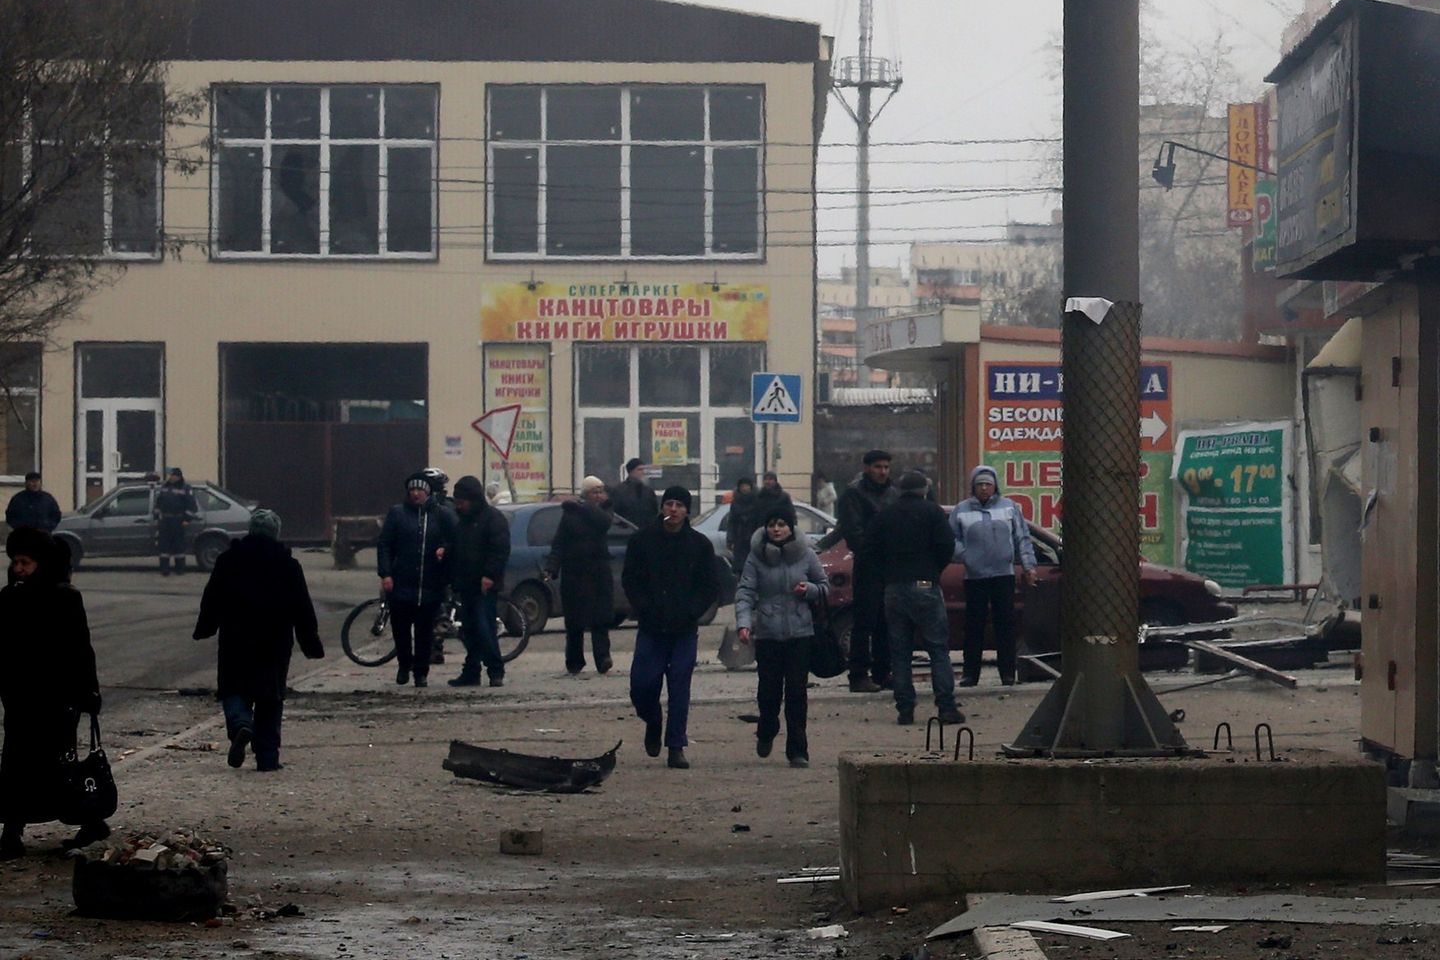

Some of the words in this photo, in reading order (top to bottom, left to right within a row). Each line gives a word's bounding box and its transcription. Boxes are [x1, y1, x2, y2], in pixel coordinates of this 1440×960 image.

[1235, 118, 1250, 206] ЛОМБАРД
[569, 285, 680, 297] СУПЕРМАРКЕТ
[539, 298, 711, 320] КАНЦТОВАРЫ
[517, 321, 601, 339] КНИГИ
[614, 321, 728, 340] ИГРУШКИ
[988, 427, 1063, 442] ОДЕЖДА
